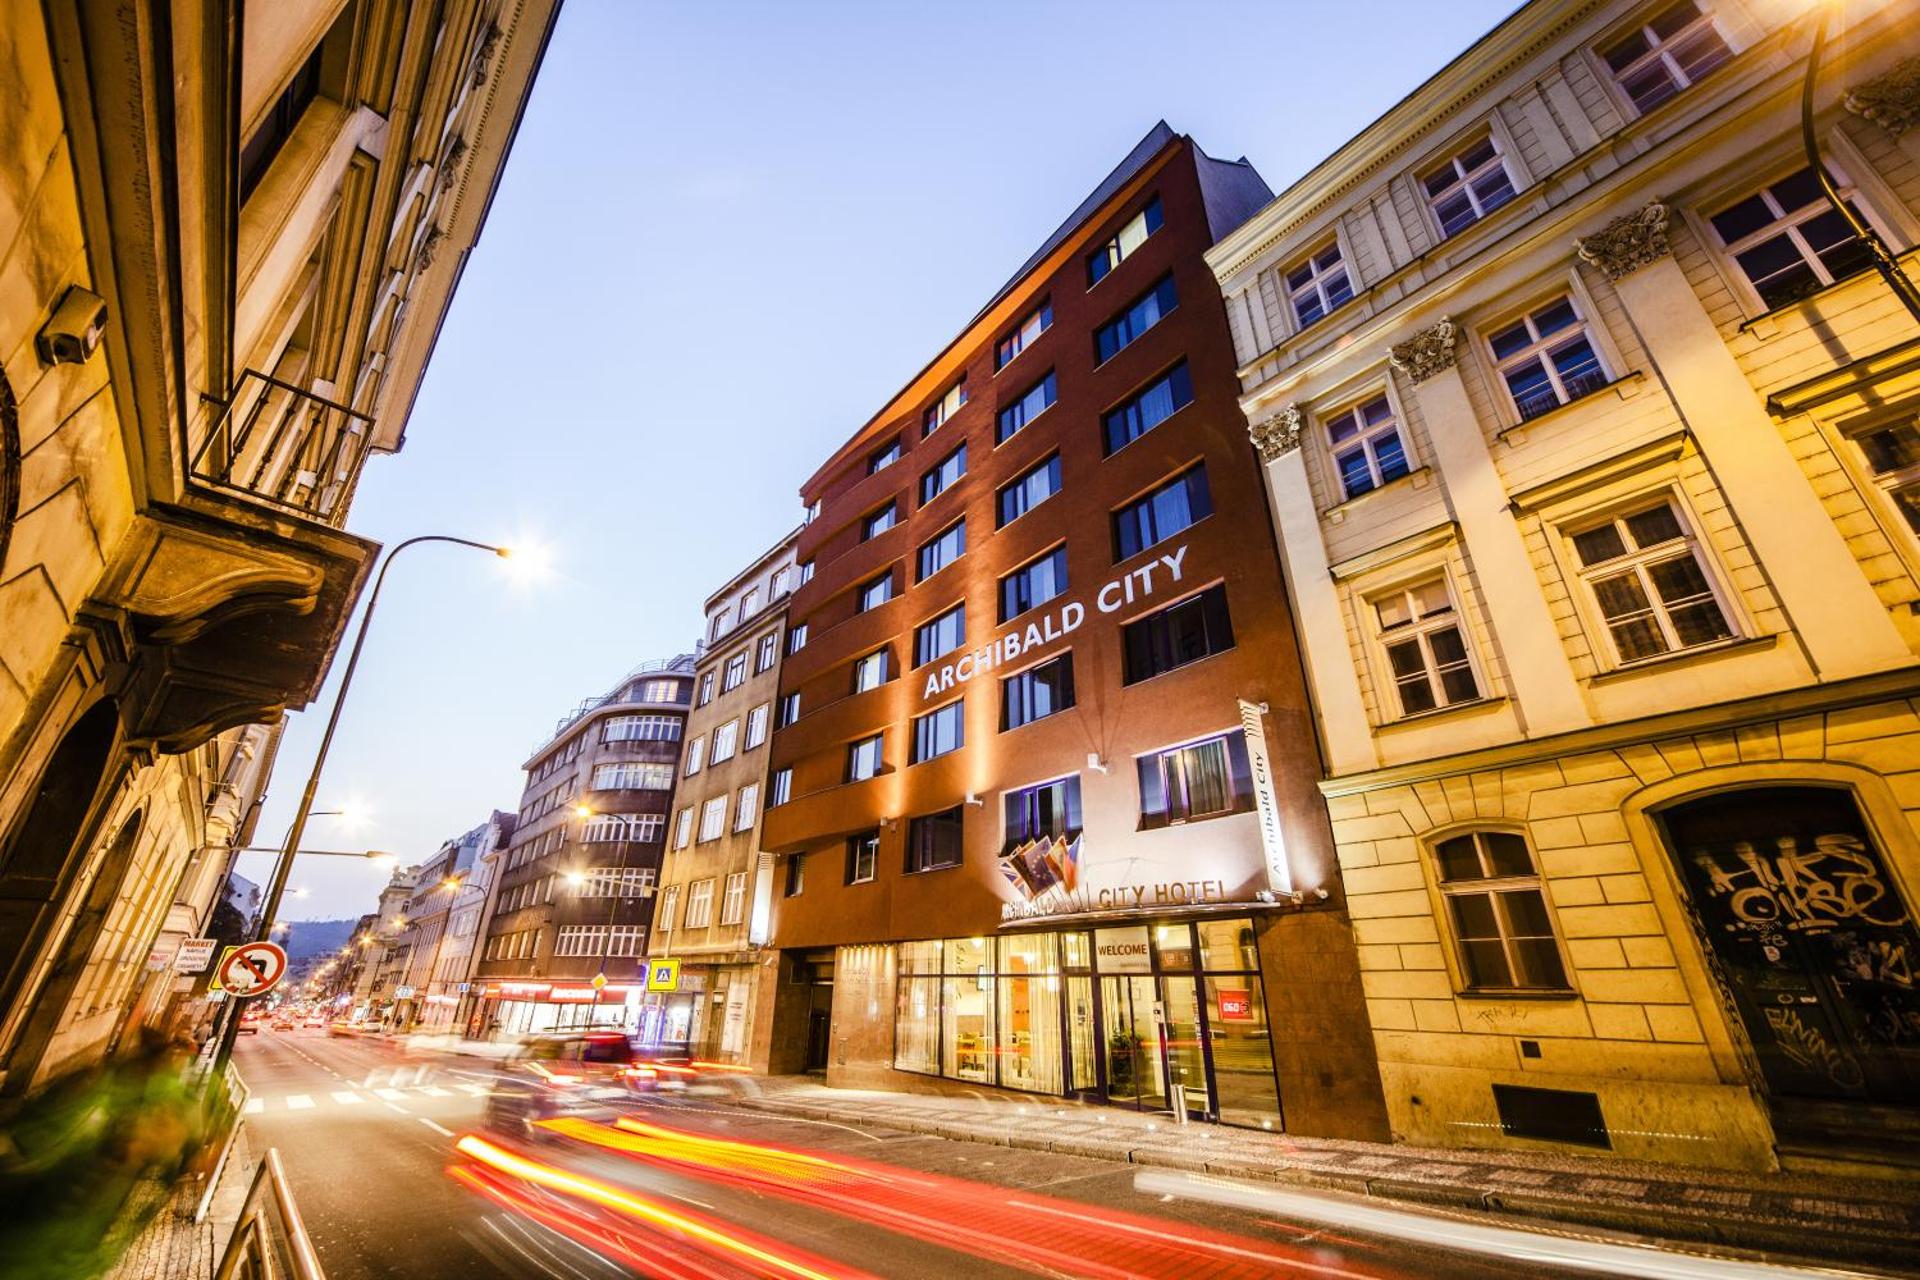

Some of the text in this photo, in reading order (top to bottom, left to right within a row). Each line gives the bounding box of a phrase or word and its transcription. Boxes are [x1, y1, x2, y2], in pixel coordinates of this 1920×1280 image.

[923, 545, 1188, 699] ARCHIBALD CITY
[1255, 751, 1266, 785] City
[1099, 885, 1145, 907] CITY
[1154, 880, 1226, 904] HOTEL
[1097, 944, 1148, 956] WELCOME
